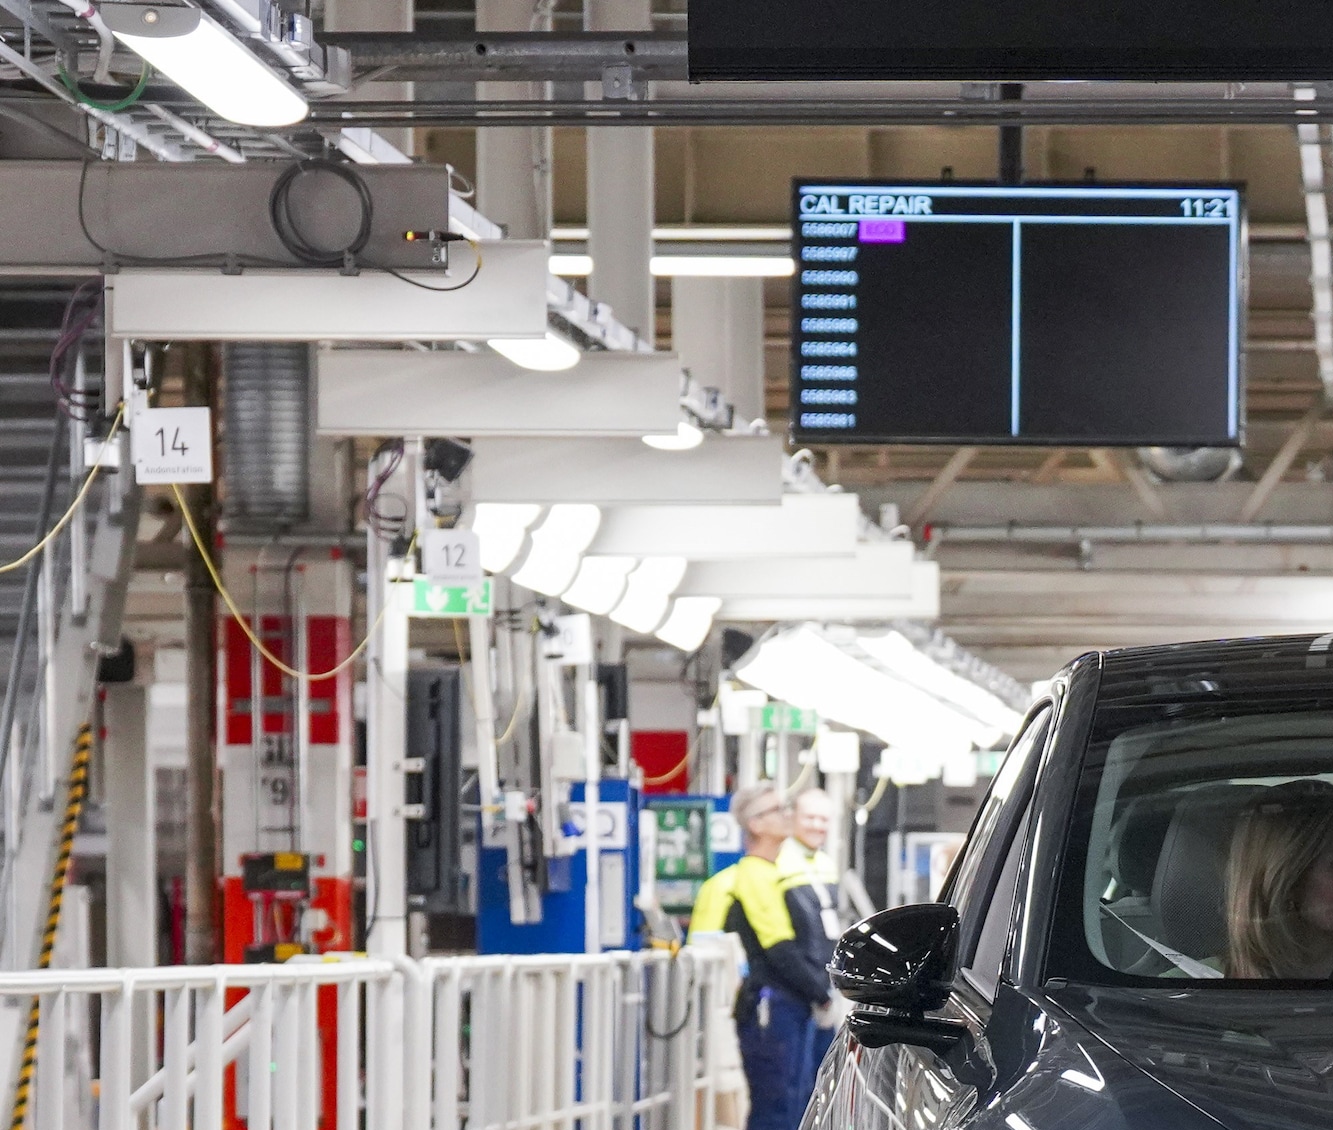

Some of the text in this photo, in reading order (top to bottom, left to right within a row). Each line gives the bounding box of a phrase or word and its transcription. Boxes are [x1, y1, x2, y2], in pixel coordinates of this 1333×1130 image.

[800, 194, 933, 215] CAL REPAIR
[1180, 197, 1233, 217] 11:21
[154, 425, 189, 457] 14
[441, 543, 467, 568] 12
